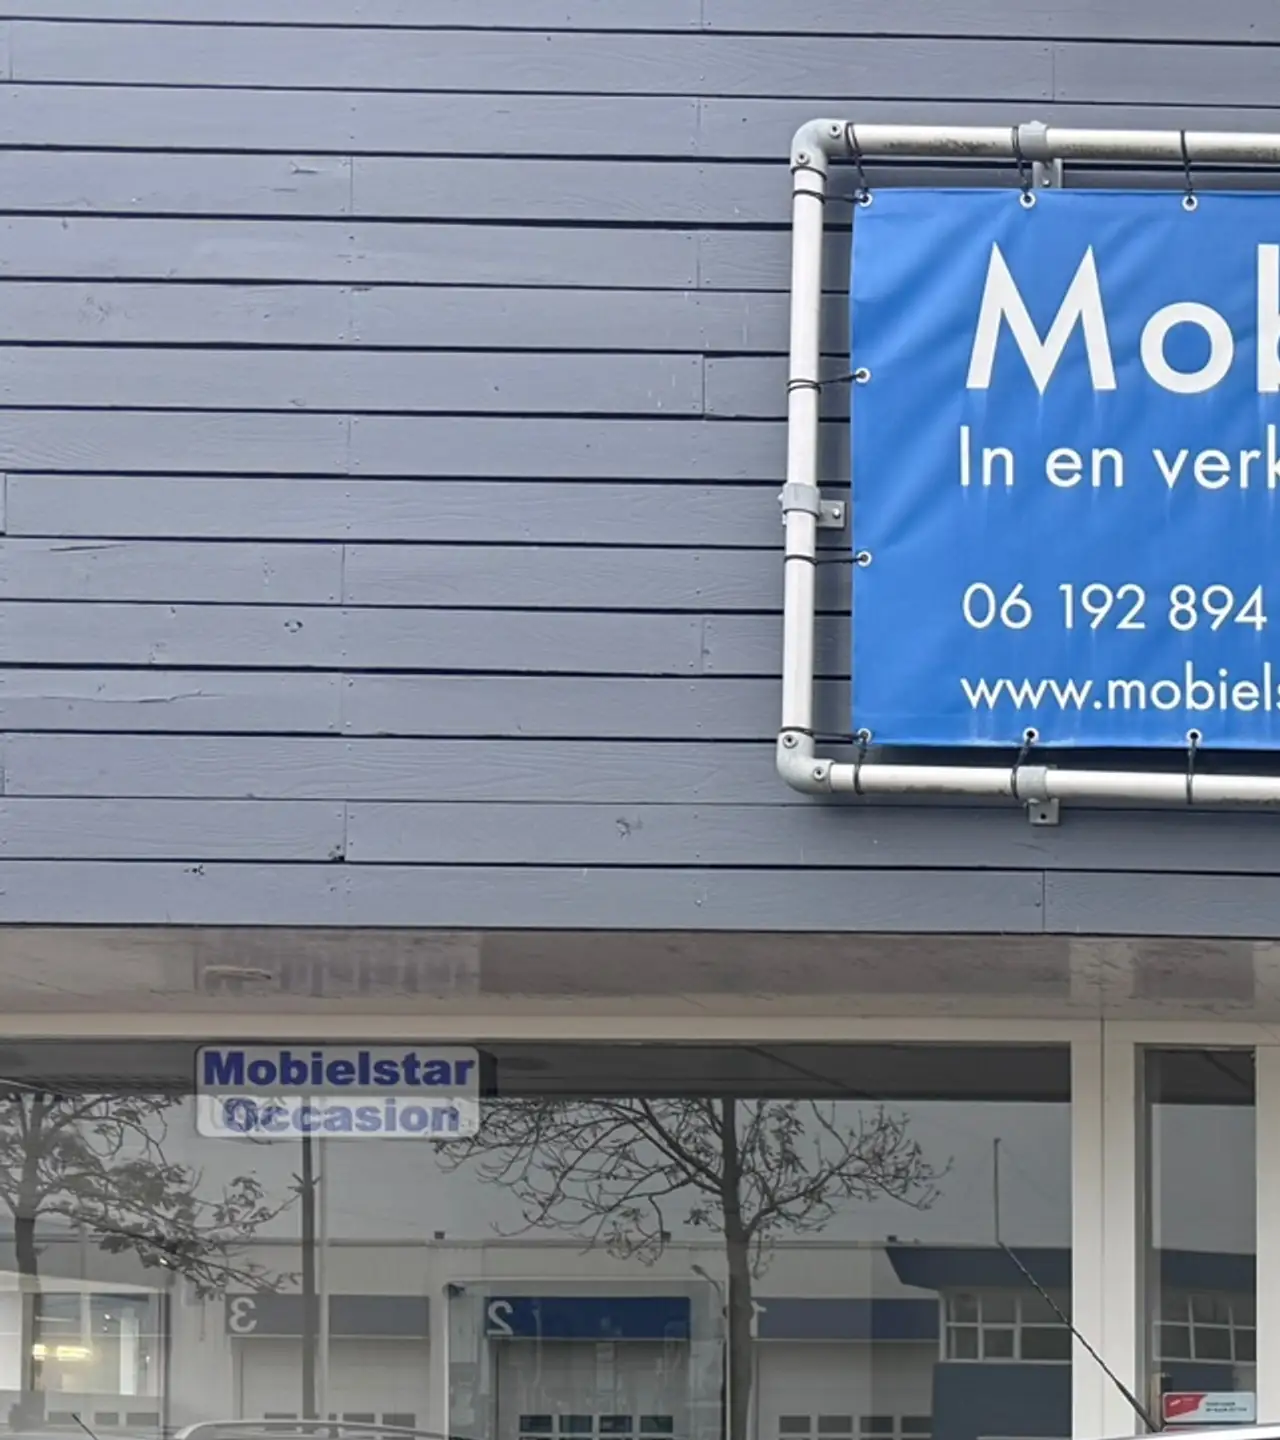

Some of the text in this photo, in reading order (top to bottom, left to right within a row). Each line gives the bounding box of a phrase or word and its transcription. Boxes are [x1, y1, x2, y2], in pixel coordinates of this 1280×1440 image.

[960, 425, 1014, 488] In
[1046, 448, 1124, 489] en
[963, 582, 1032, 630] 06
[1059, 582, 1145, 630] 192
[1169, 583, 1268, 632] 894
[203, 1050, 476, 1087] Mobielstar
[222, 1098, 461, 1133] Occasion
